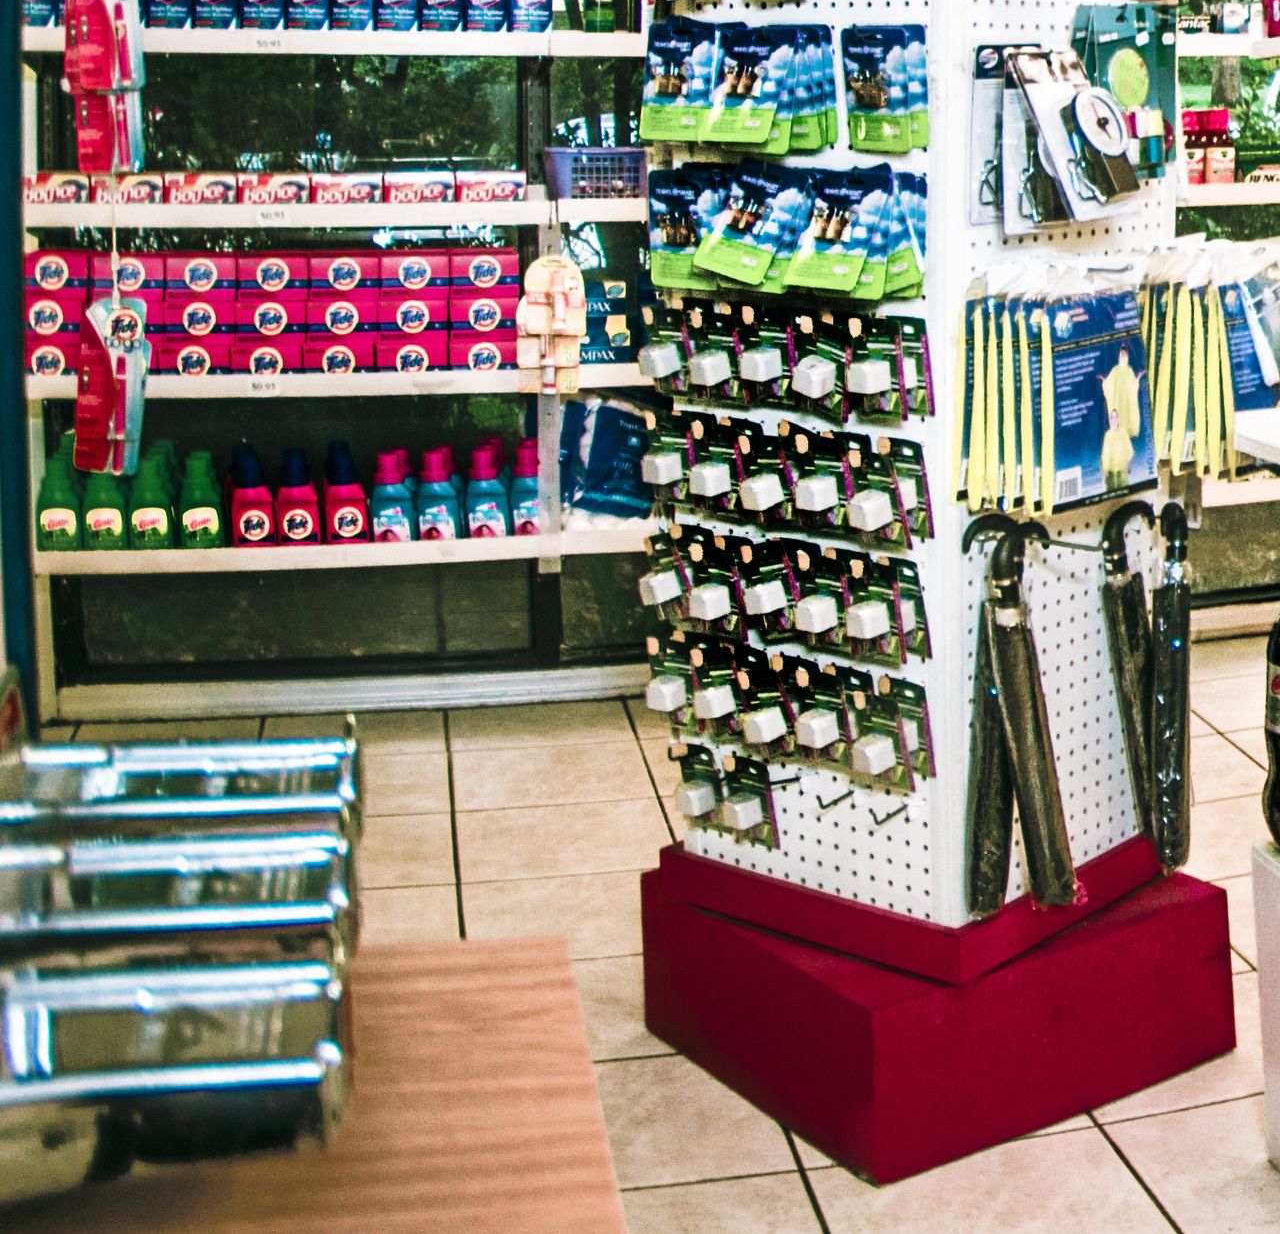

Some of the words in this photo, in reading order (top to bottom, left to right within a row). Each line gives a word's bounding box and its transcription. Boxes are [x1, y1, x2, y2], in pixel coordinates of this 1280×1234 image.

[171, 186, 225, 203] bounce
[245, 184, 299, 203] bounce
[317, 182, 372, 203] bounce
[389, 182, 445, 203] bounce
[461, 182, 517, 202] bounce
[39, 261, 65, 282] Tide
[187, 264, 215, 285] Tide
[260, 264, 287, 284] Tide
[331, 264, 358, 283] Tide
[401, 263, 428, 283] Tide
[471, 261, 499, 282] Tide
[33, 307, 59, 327] Tide
[185, 308, 212, 328] Tide
[257, 308, 285, 328] Tide
[329, 307, 356, 327] Tide
[400, 306, 426, 326] Tide
[471, 305, 499, 325] Tide
[110, 318, 137, 339] Tide
[471, 349, 498, 367] Tide
